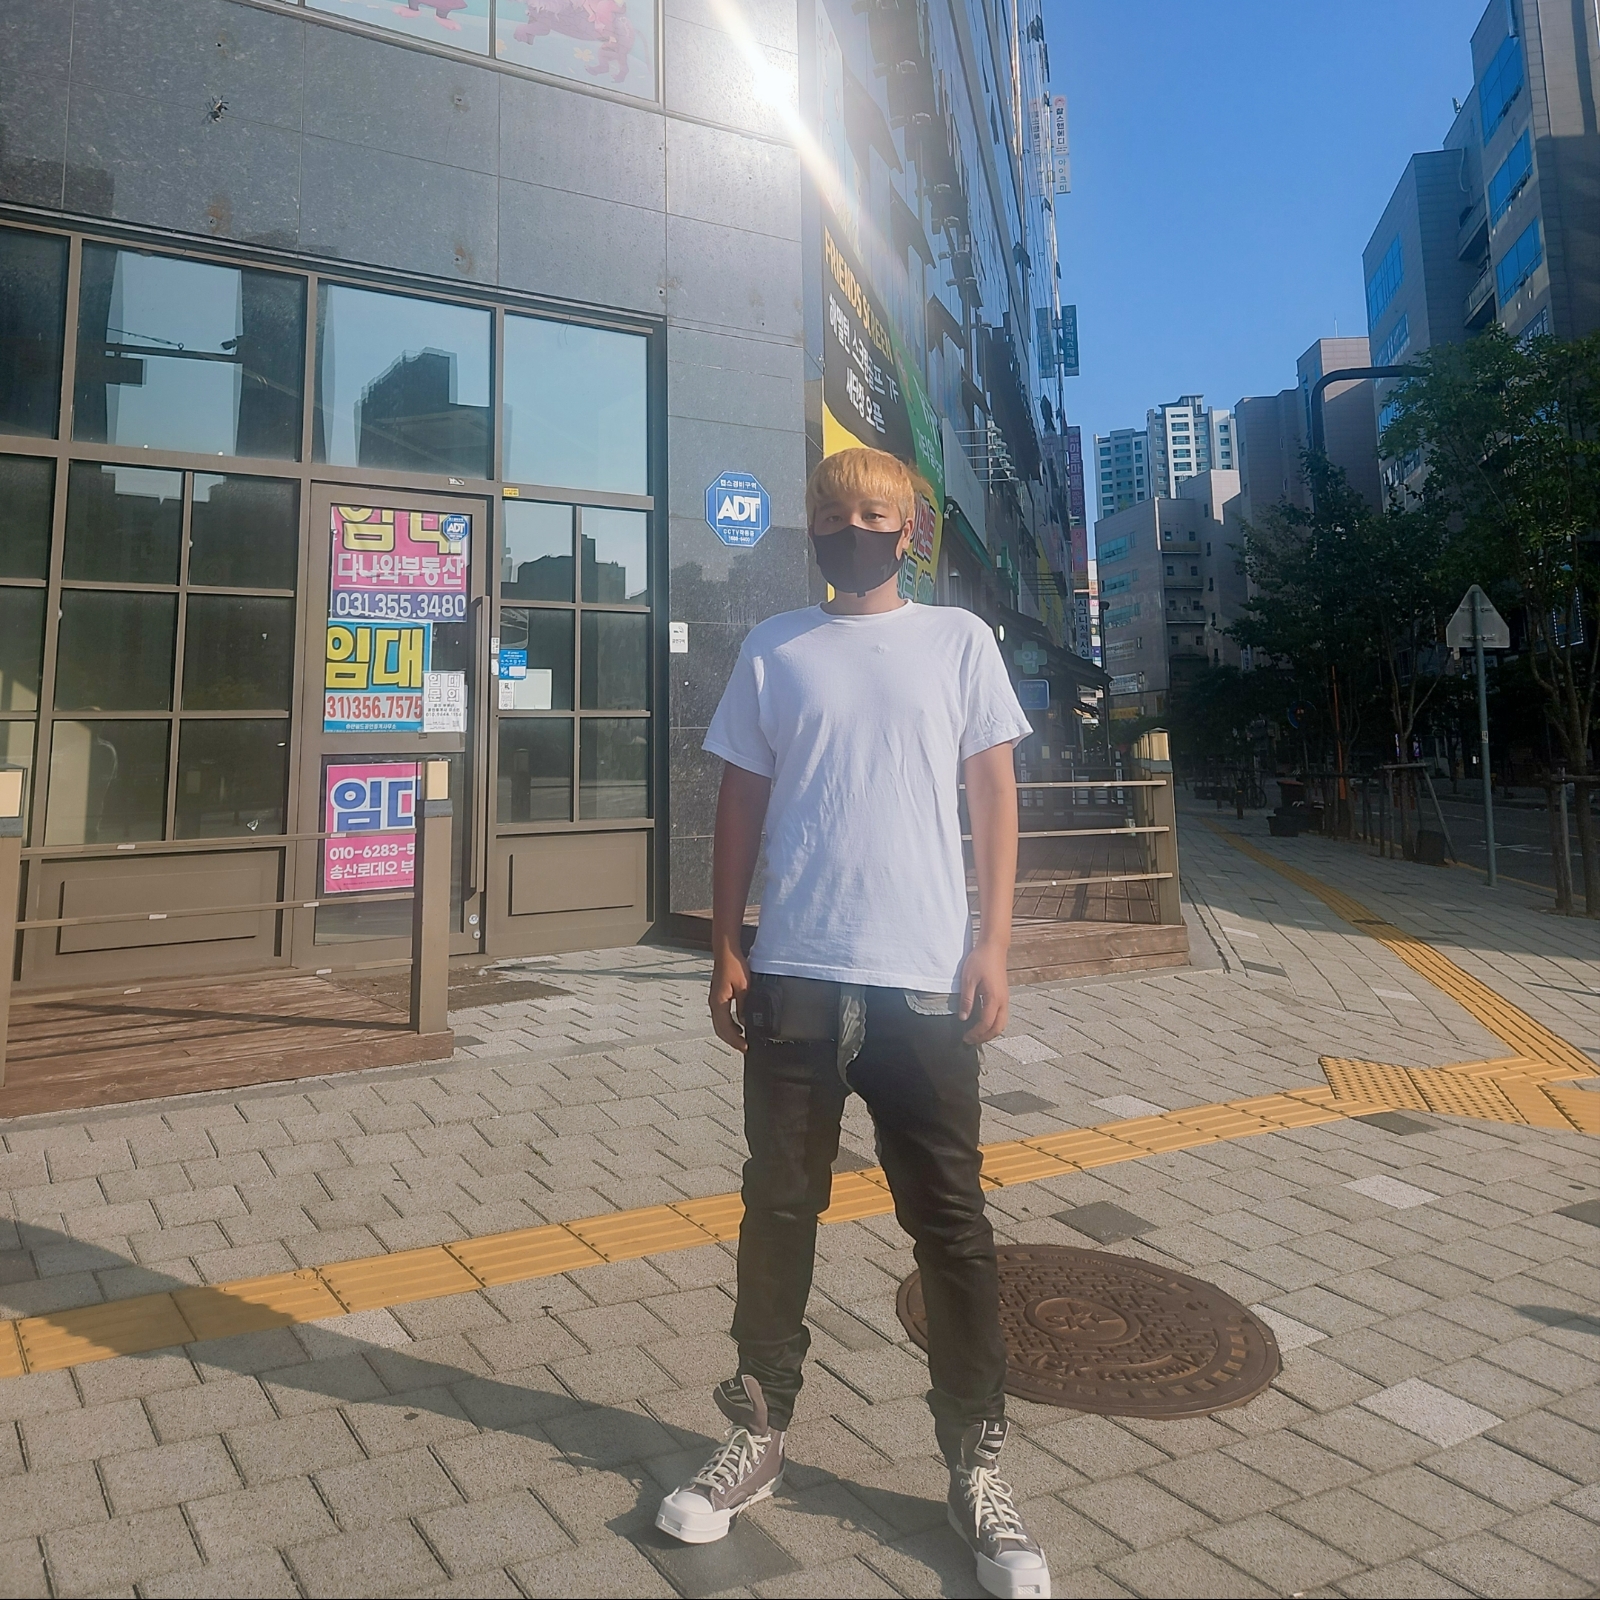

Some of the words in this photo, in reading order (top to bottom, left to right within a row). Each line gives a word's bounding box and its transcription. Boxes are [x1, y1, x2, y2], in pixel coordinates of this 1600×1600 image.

[824, 225, 862, 319] FRIENDS
[862, 294, 894, 366] SCREEN
[852, 329, 886, 395] 스크린골프
[866, 395, 886, 434] 오픈
[1069, 443, 1082, 474] 아로마
[717, 495, 760, 522] ADT
[447, 523, 466, 534] ADT
[337, 553, 464, 587] 다나와부동산
[336, 593, 467, 618] 031.355.3480
[325, 625, 424, 690] 임대
[1022, 651, 1038, 668] 약
[324, 695, 423, 720] 31)356.7575
[330, 861, 398, 880] 송산로데오
